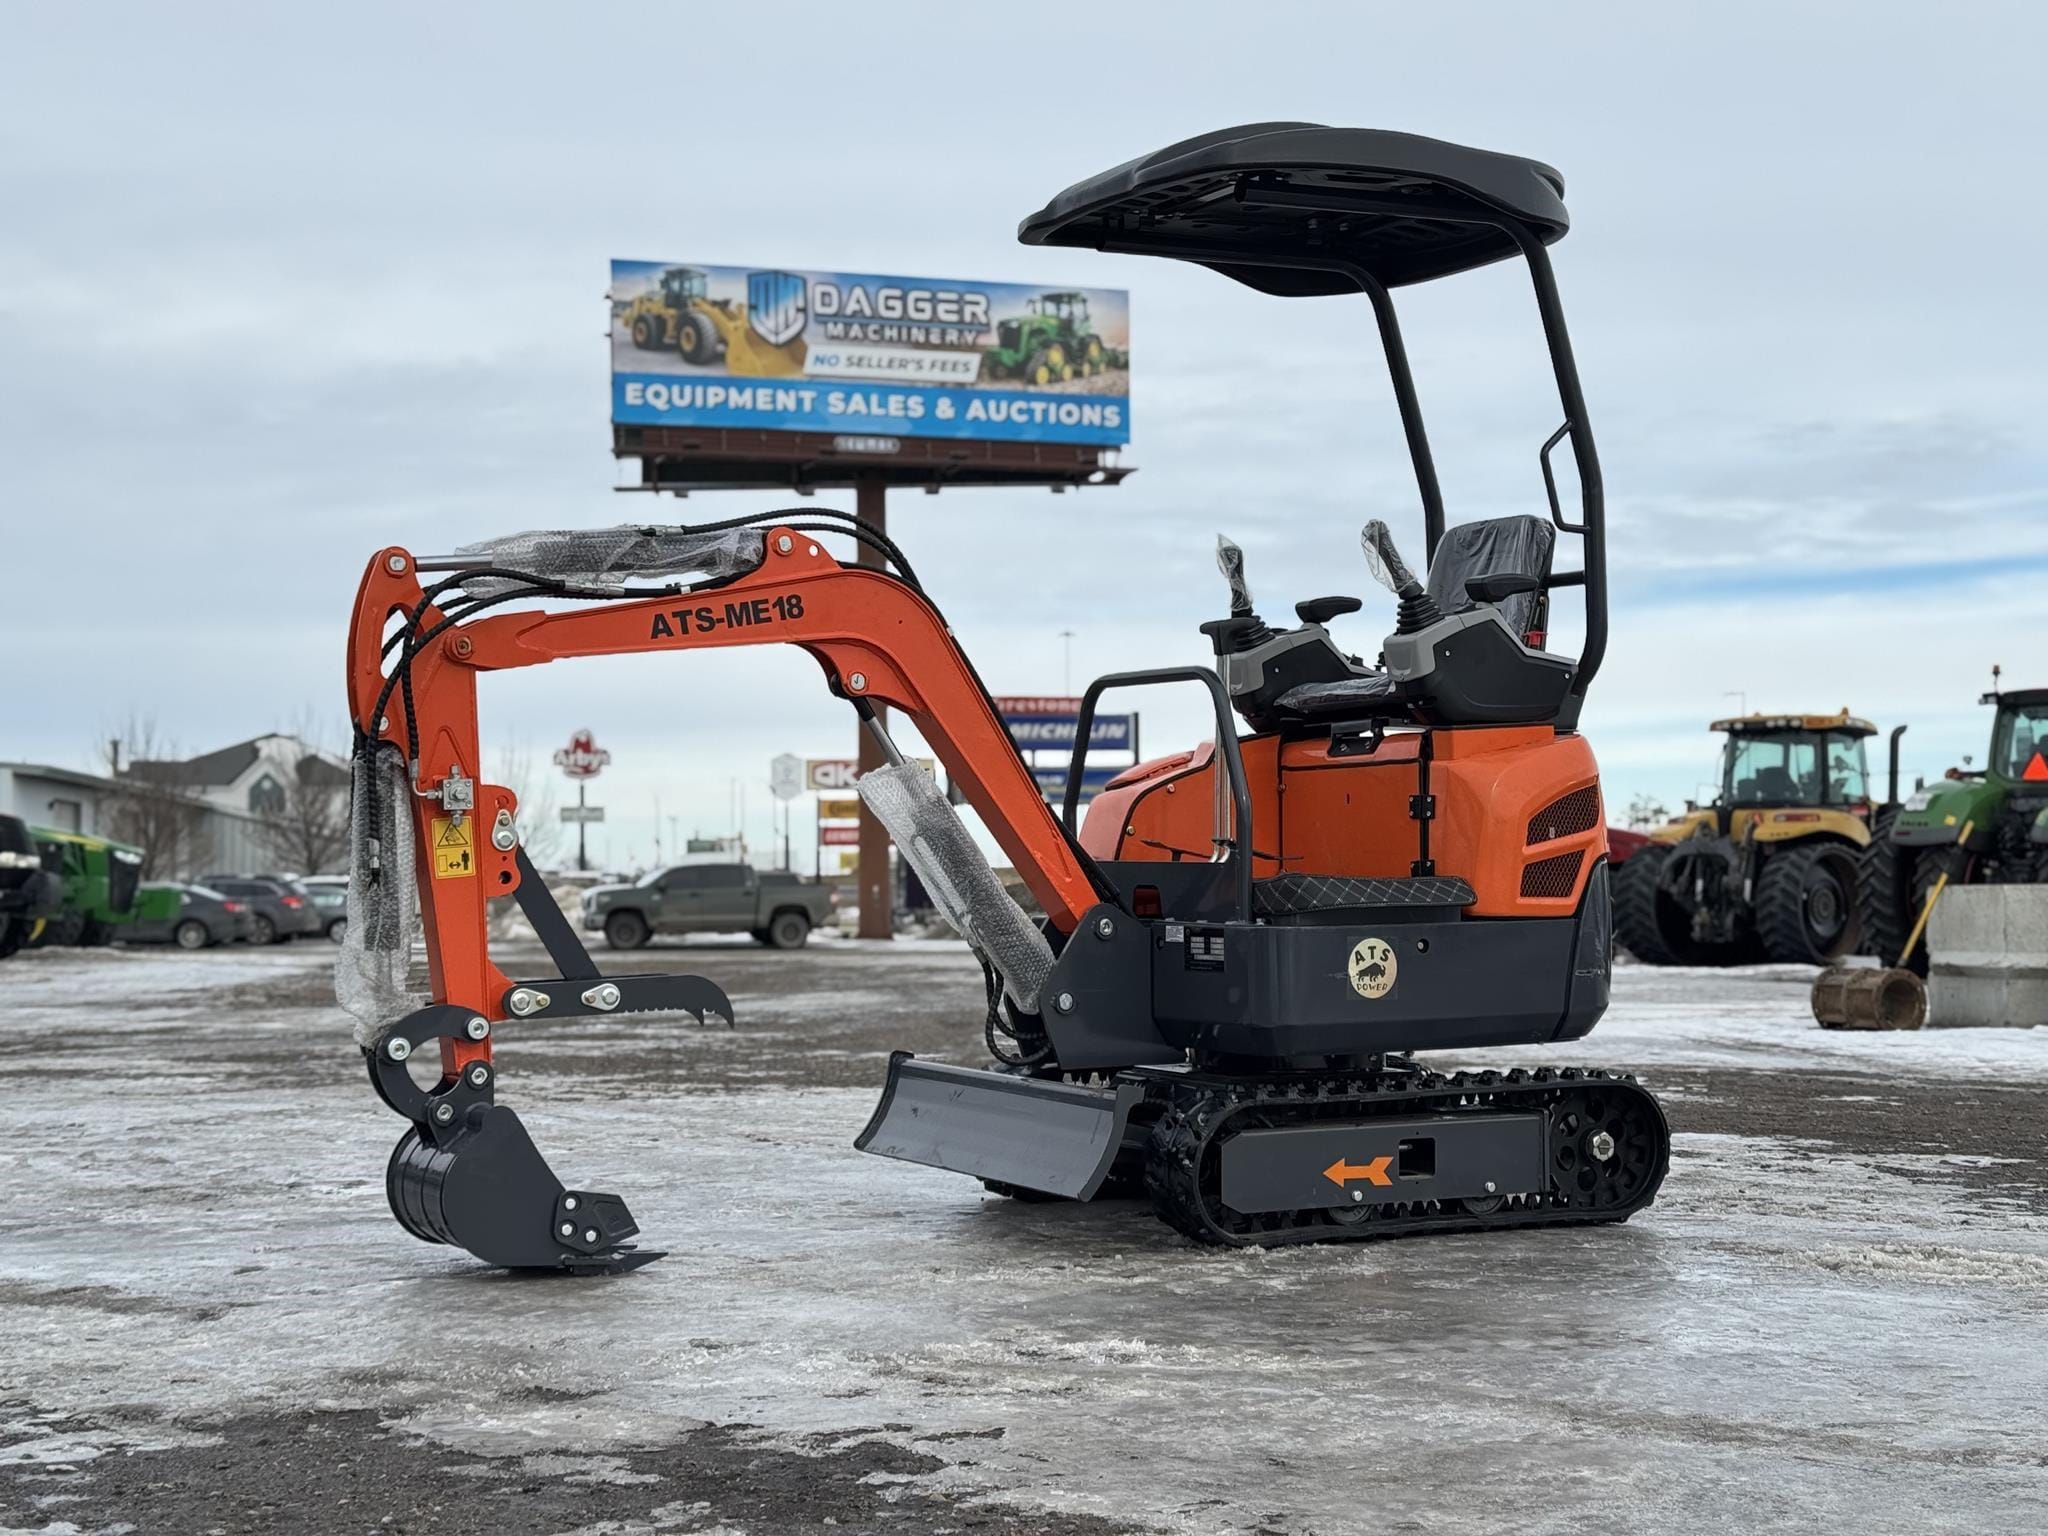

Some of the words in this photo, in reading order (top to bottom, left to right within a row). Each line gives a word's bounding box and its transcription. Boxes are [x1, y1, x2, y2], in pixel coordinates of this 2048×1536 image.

[812, 282, 991, 325] DAGGER
[824, 321, 979, 346] MACHINERY
[812, 353, 840, 369] NO
[844, 355, 925, 373] SELLER'S
[929, 359, 972, 375] FEES
[623, 382, 817, 414] EQUIPMENT
[828, 392, 925, 419] SALES
[935, 397, 956, 421] &
[965, 398, 1122, 428] AUCTIONS
[650, 594, 805, 640] ATS-ME18
[1354, 945, 1392, 966] ATS
[1356, 982, 1389, 992] POWER
